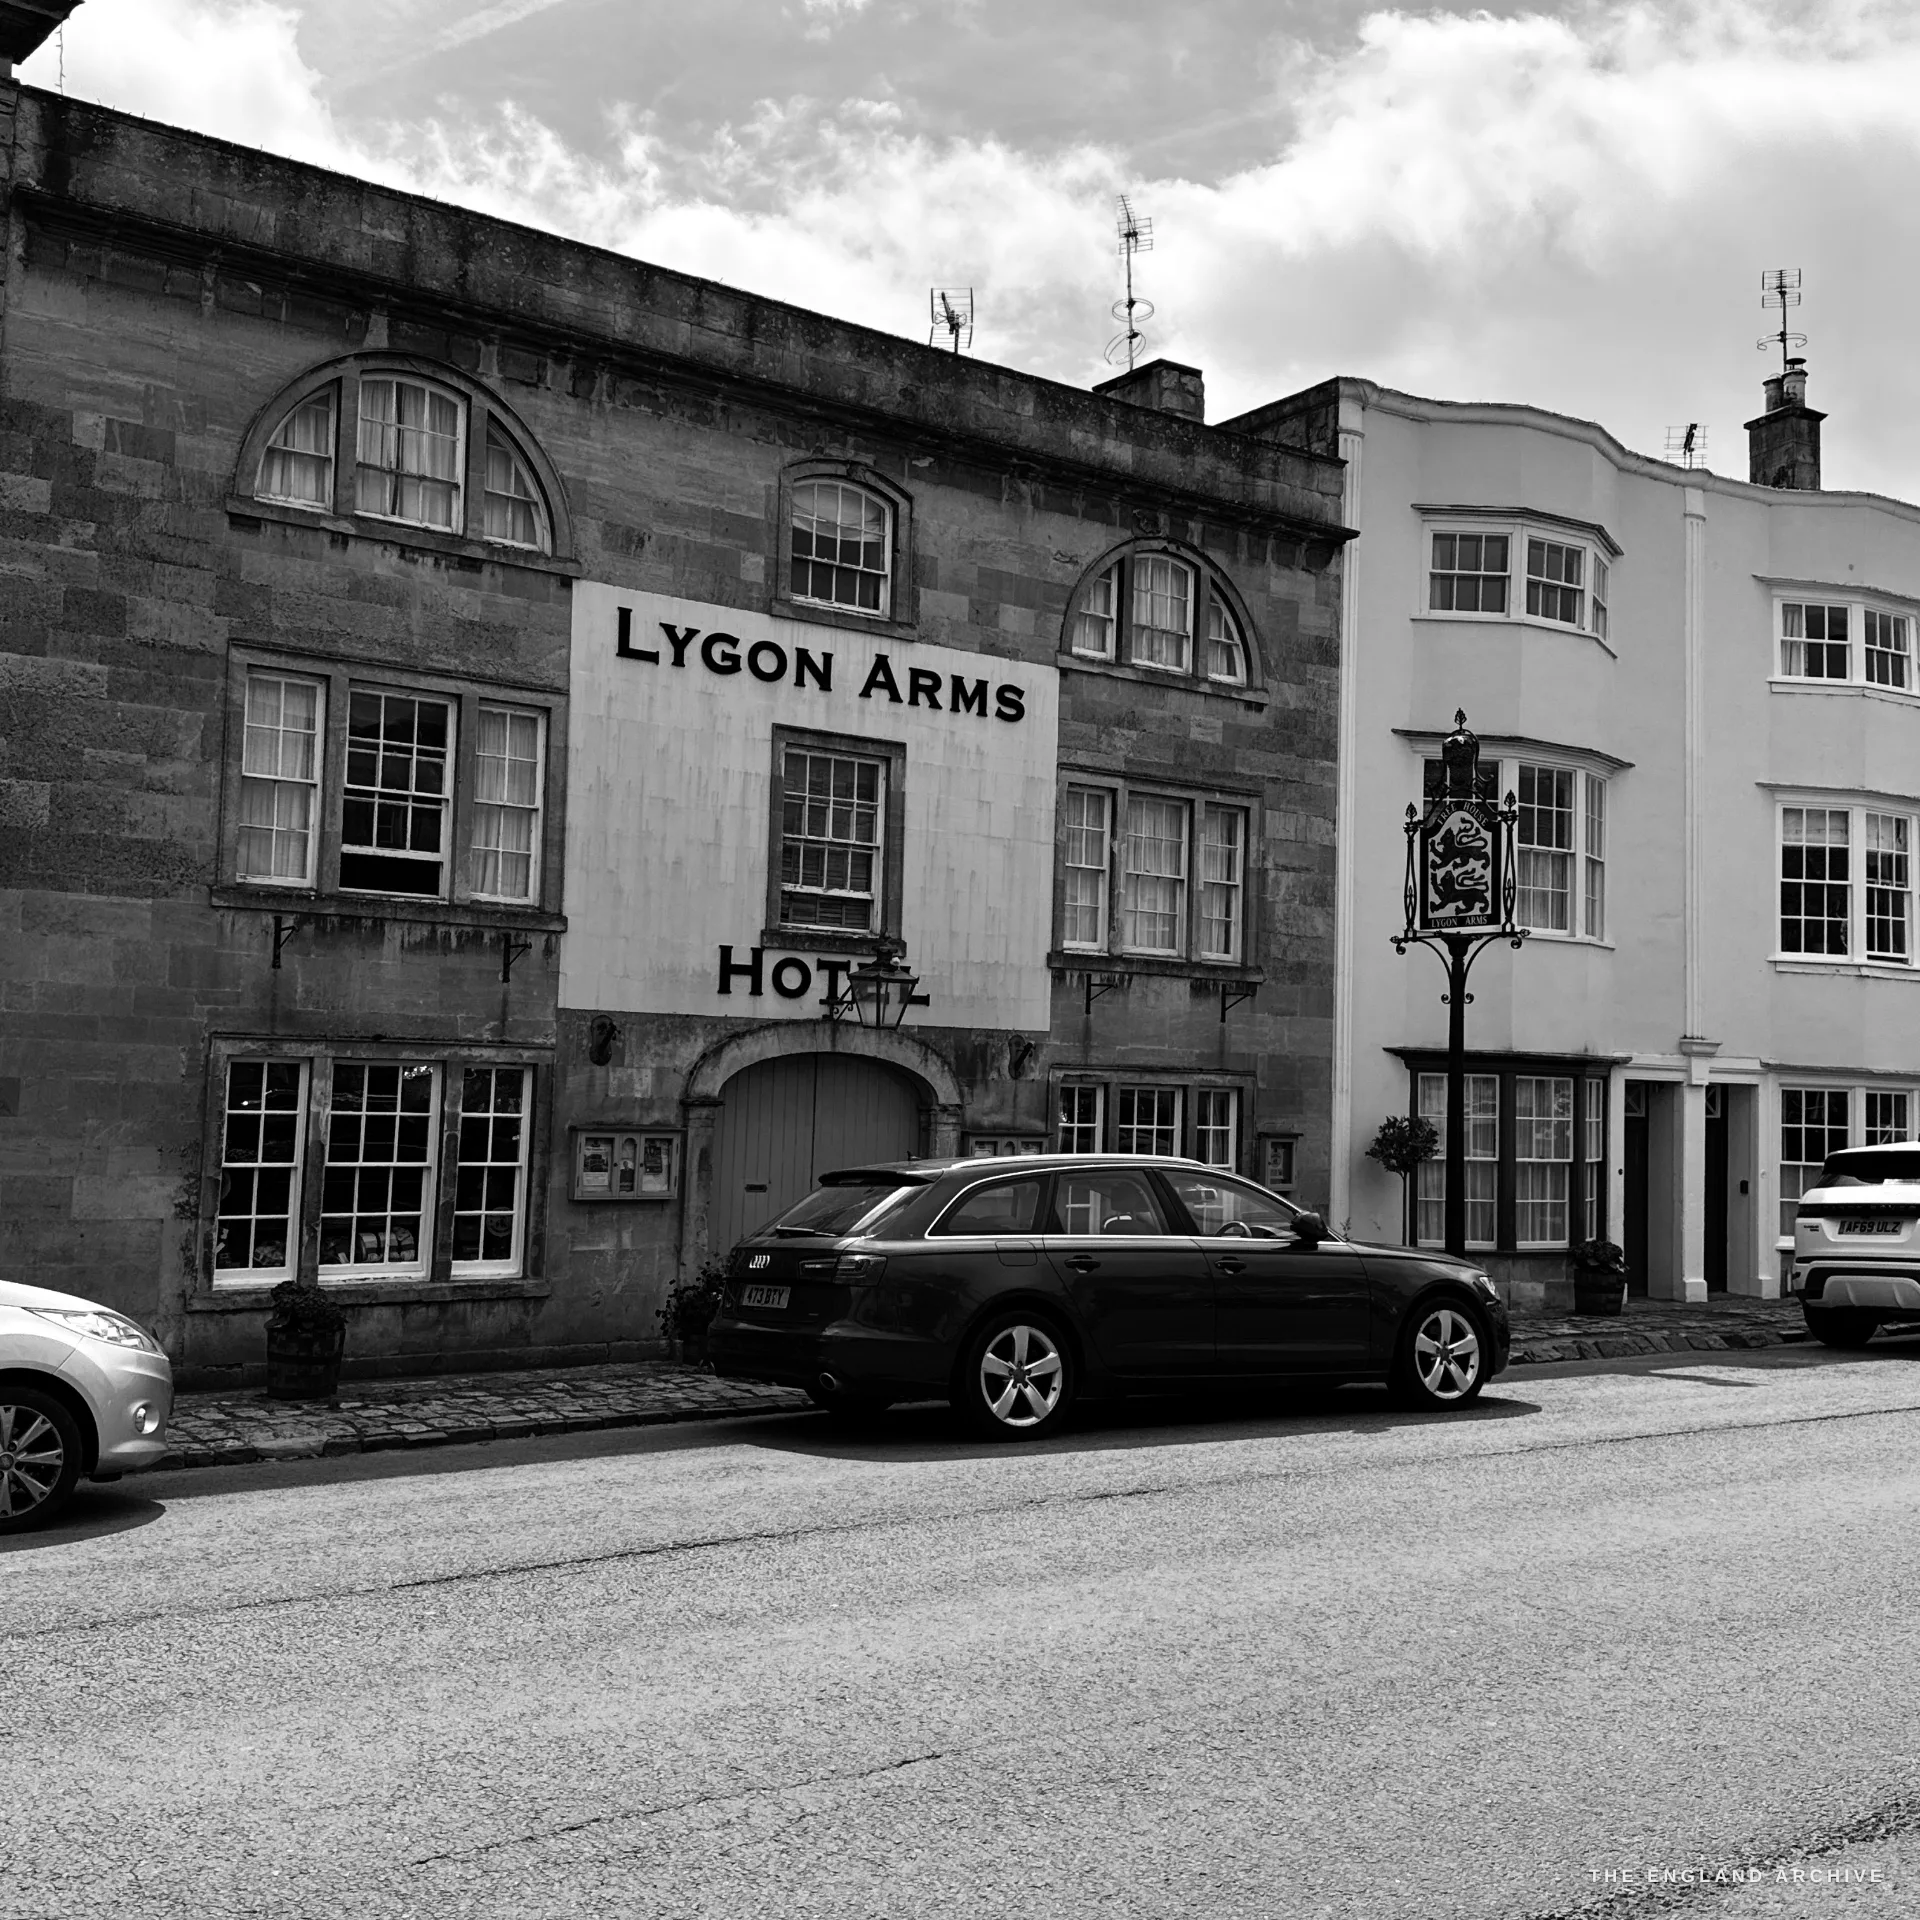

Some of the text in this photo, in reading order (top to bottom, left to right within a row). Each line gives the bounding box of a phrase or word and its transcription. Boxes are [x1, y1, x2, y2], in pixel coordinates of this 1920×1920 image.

[616, 606, 1026, 723] LYGON ARMS
[1437, 801, 1489, 827] FREE HOUSE
[1431, 916, 1488, 928] LYGON ARMS
[1845, 1221, 1901, 1233] AF69 ULZ
